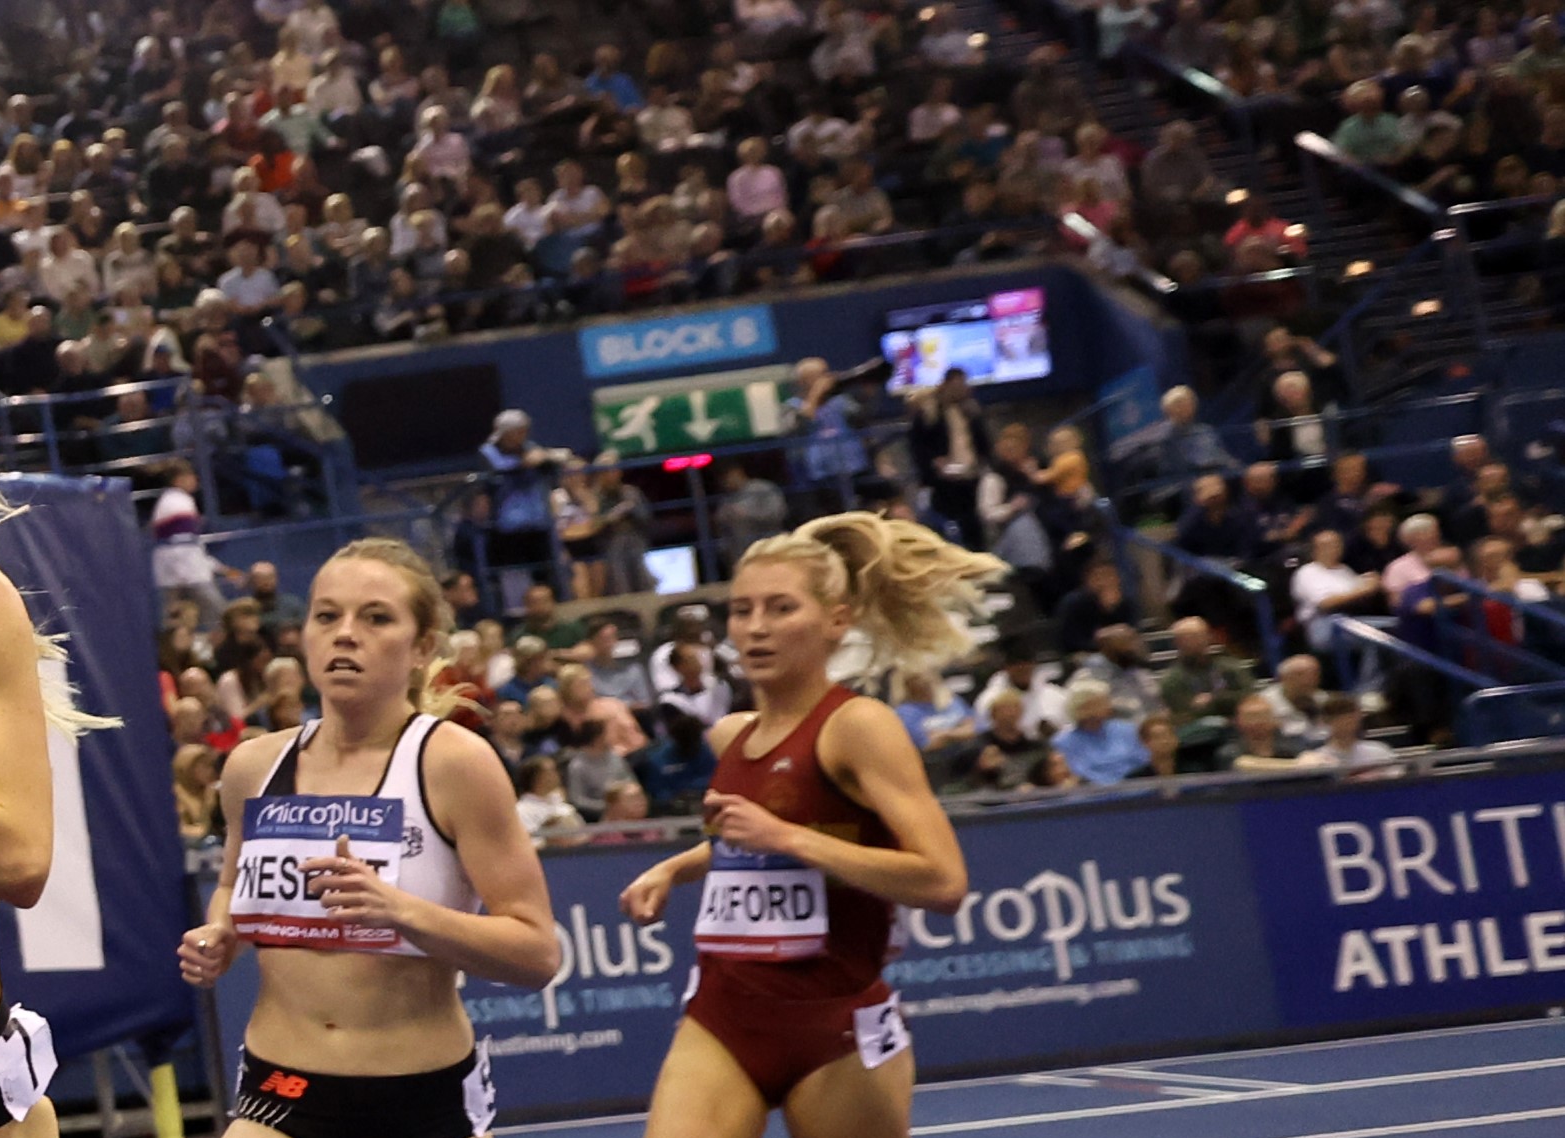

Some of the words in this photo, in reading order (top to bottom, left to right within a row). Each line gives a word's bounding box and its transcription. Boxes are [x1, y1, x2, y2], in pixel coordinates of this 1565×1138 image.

[597, 322, 726, 366] BLOCK
[256, 800, 384, 838] Microplus
[1335, 910, 1565, 993] ATHLE
